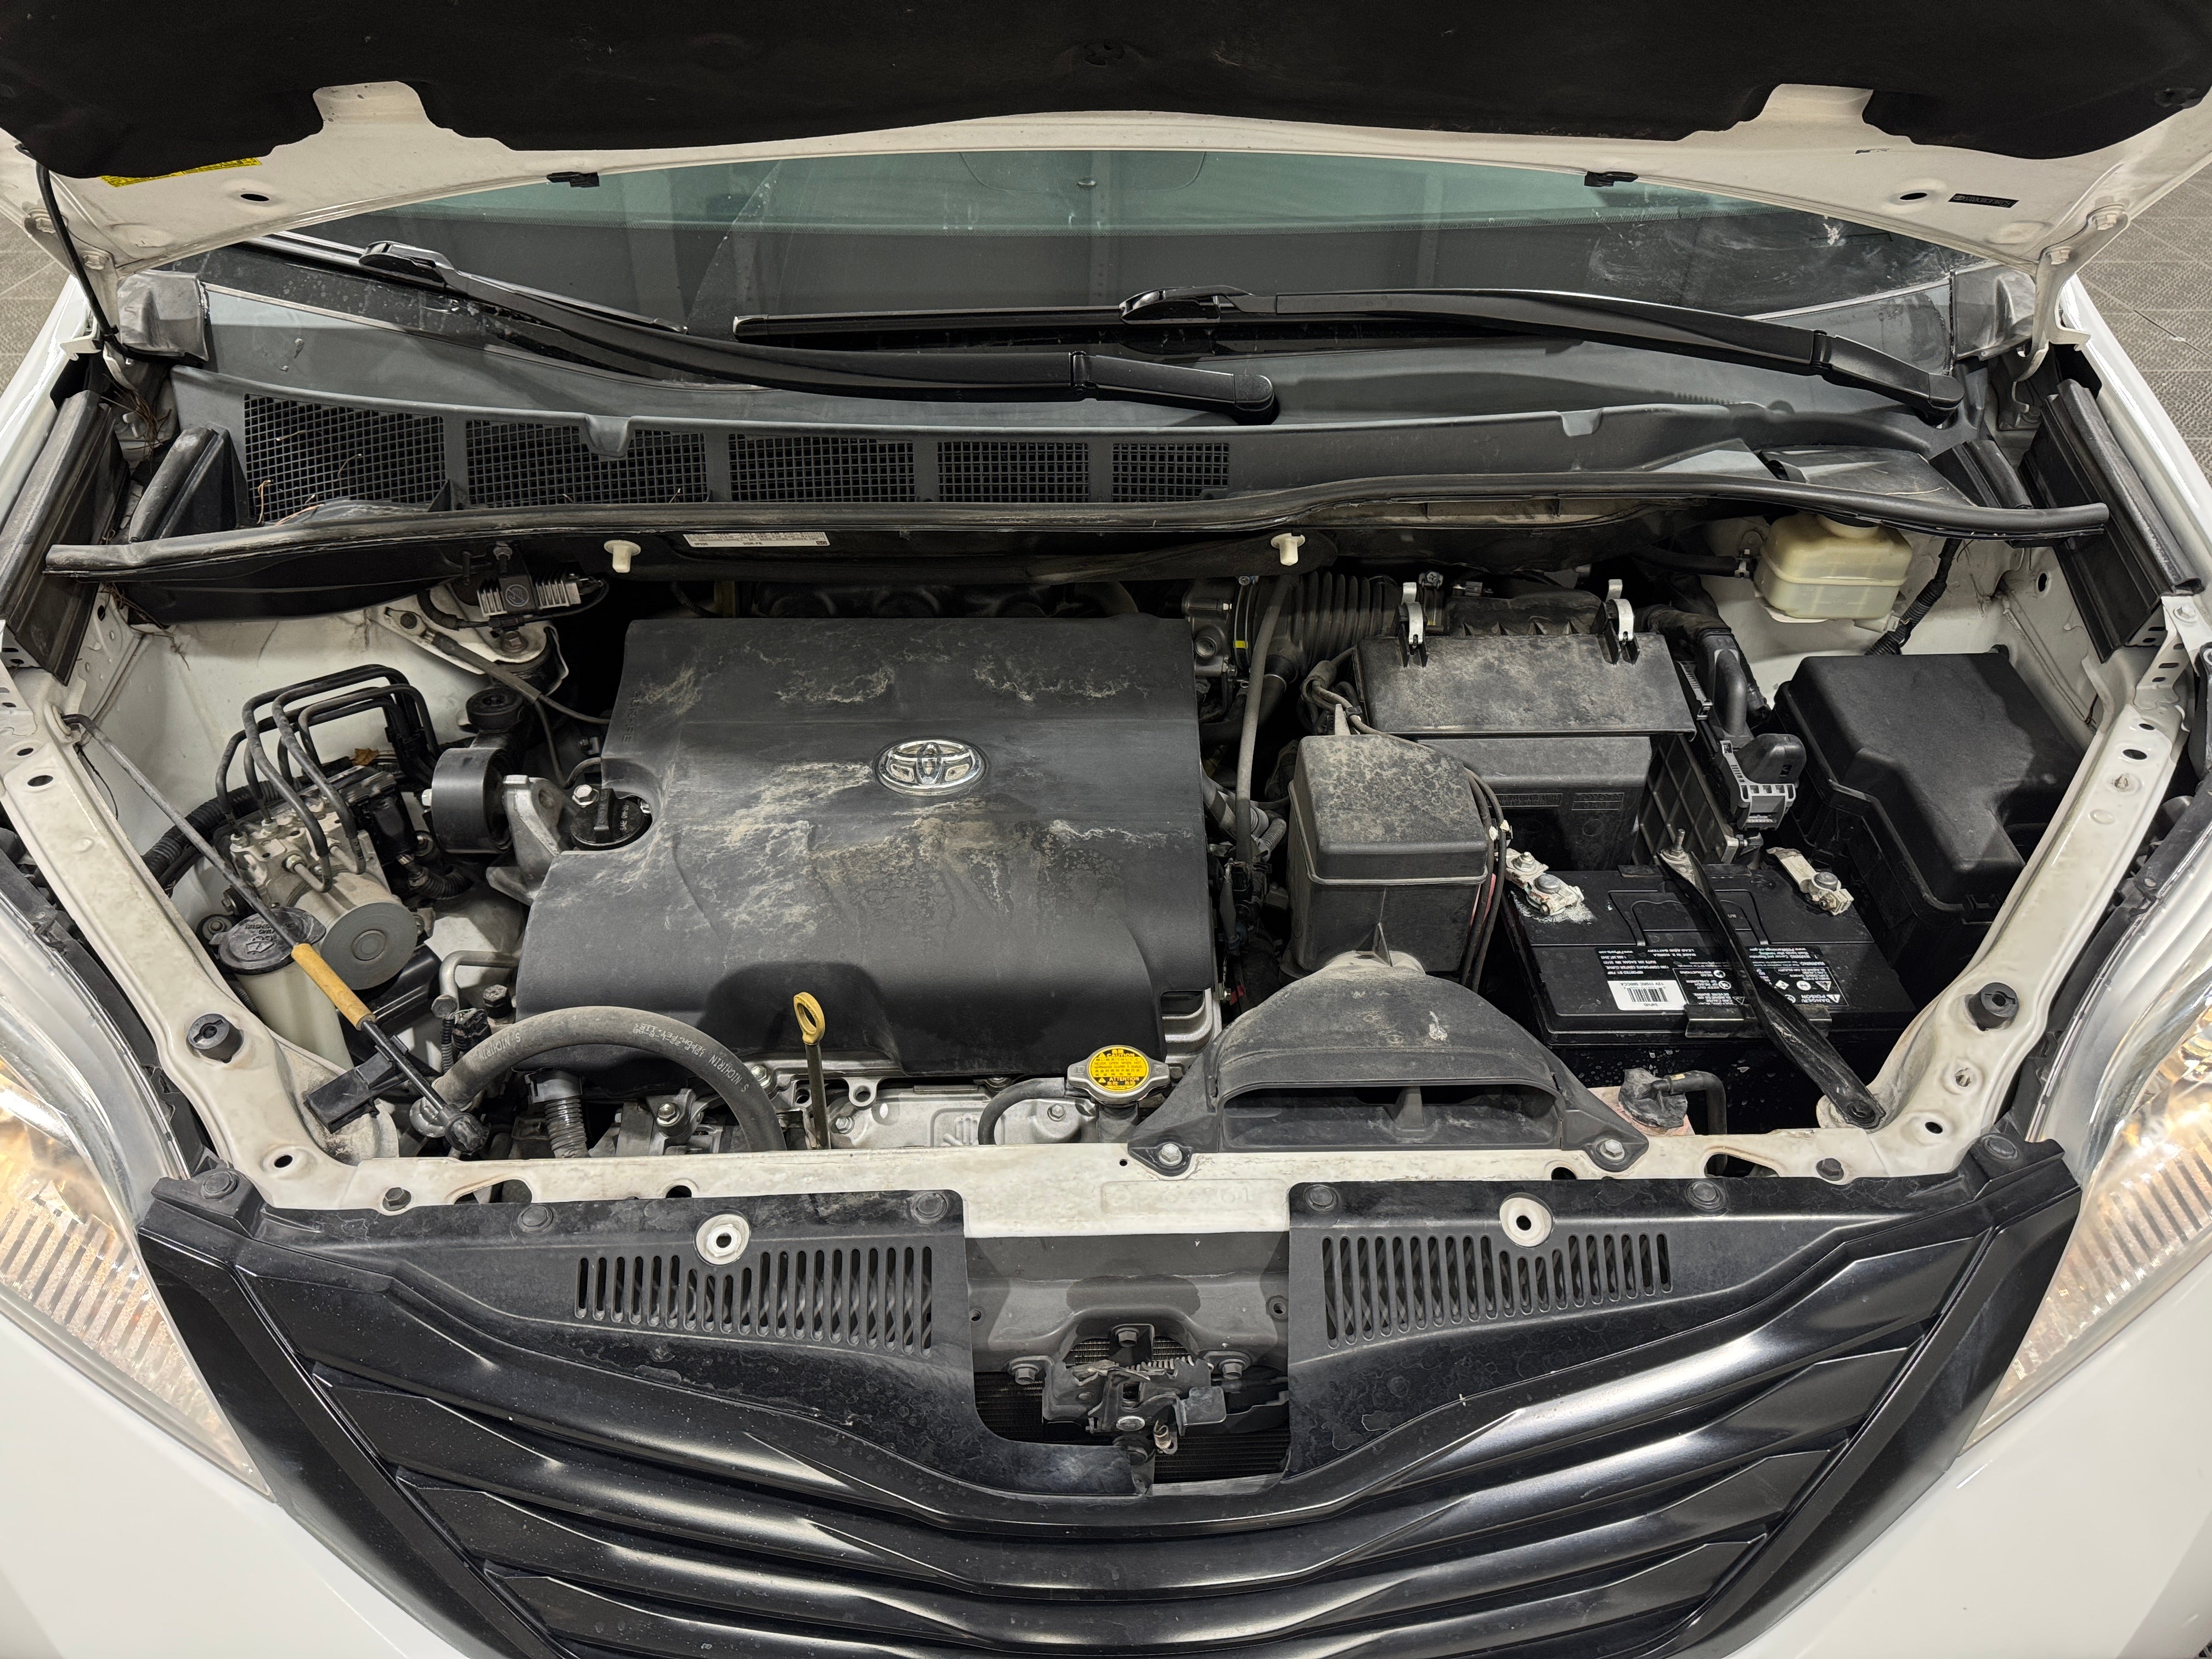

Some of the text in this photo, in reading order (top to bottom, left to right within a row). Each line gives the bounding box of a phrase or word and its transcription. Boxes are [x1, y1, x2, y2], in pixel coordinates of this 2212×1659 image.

[619, 821, 628, 831] SAE
[479, 1032, 521, 1062] S NICHIRIN
[709, 1054, 742, 1085] NICHIRIN
[741, 1084, 749, 1093] S
